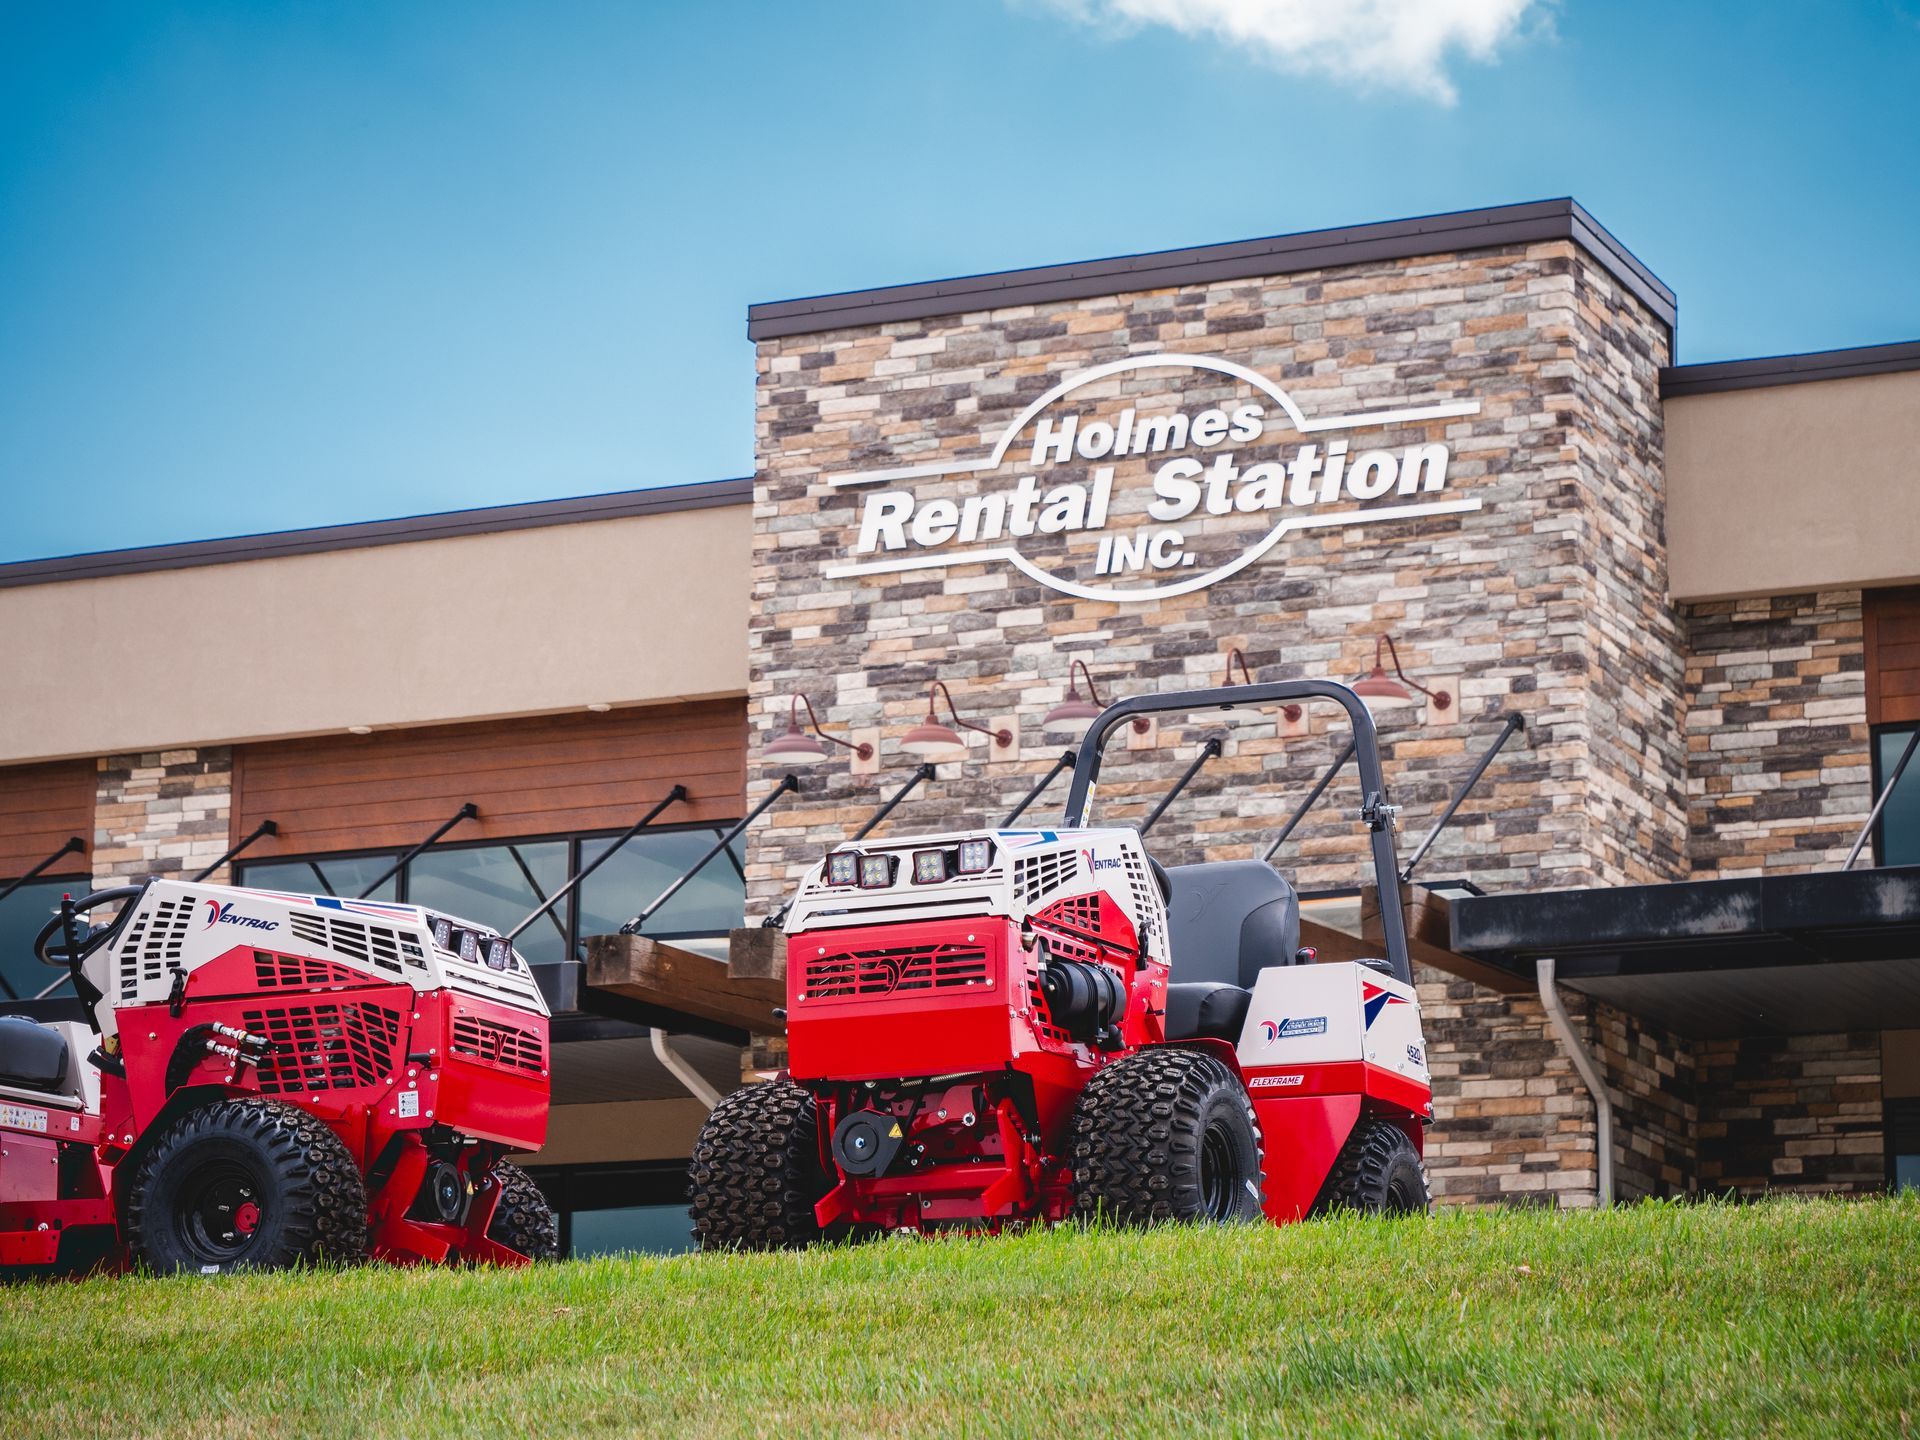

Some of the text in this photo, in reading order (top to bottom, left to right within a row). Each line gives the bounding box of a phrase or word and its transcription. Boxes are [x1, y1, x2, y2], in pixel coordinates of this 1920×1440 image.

[1030, 404, 1264, 466] Holmes
[857, 440, 1450, 553] Rental Station
[1095, 530, 1196, 575] INC.
[1081, 848, 1121, 883] VENTRAC
[202, 899, 279, 931] VENTRAC
[1252, 1076, 1301, 1086] FLEXFRAME
